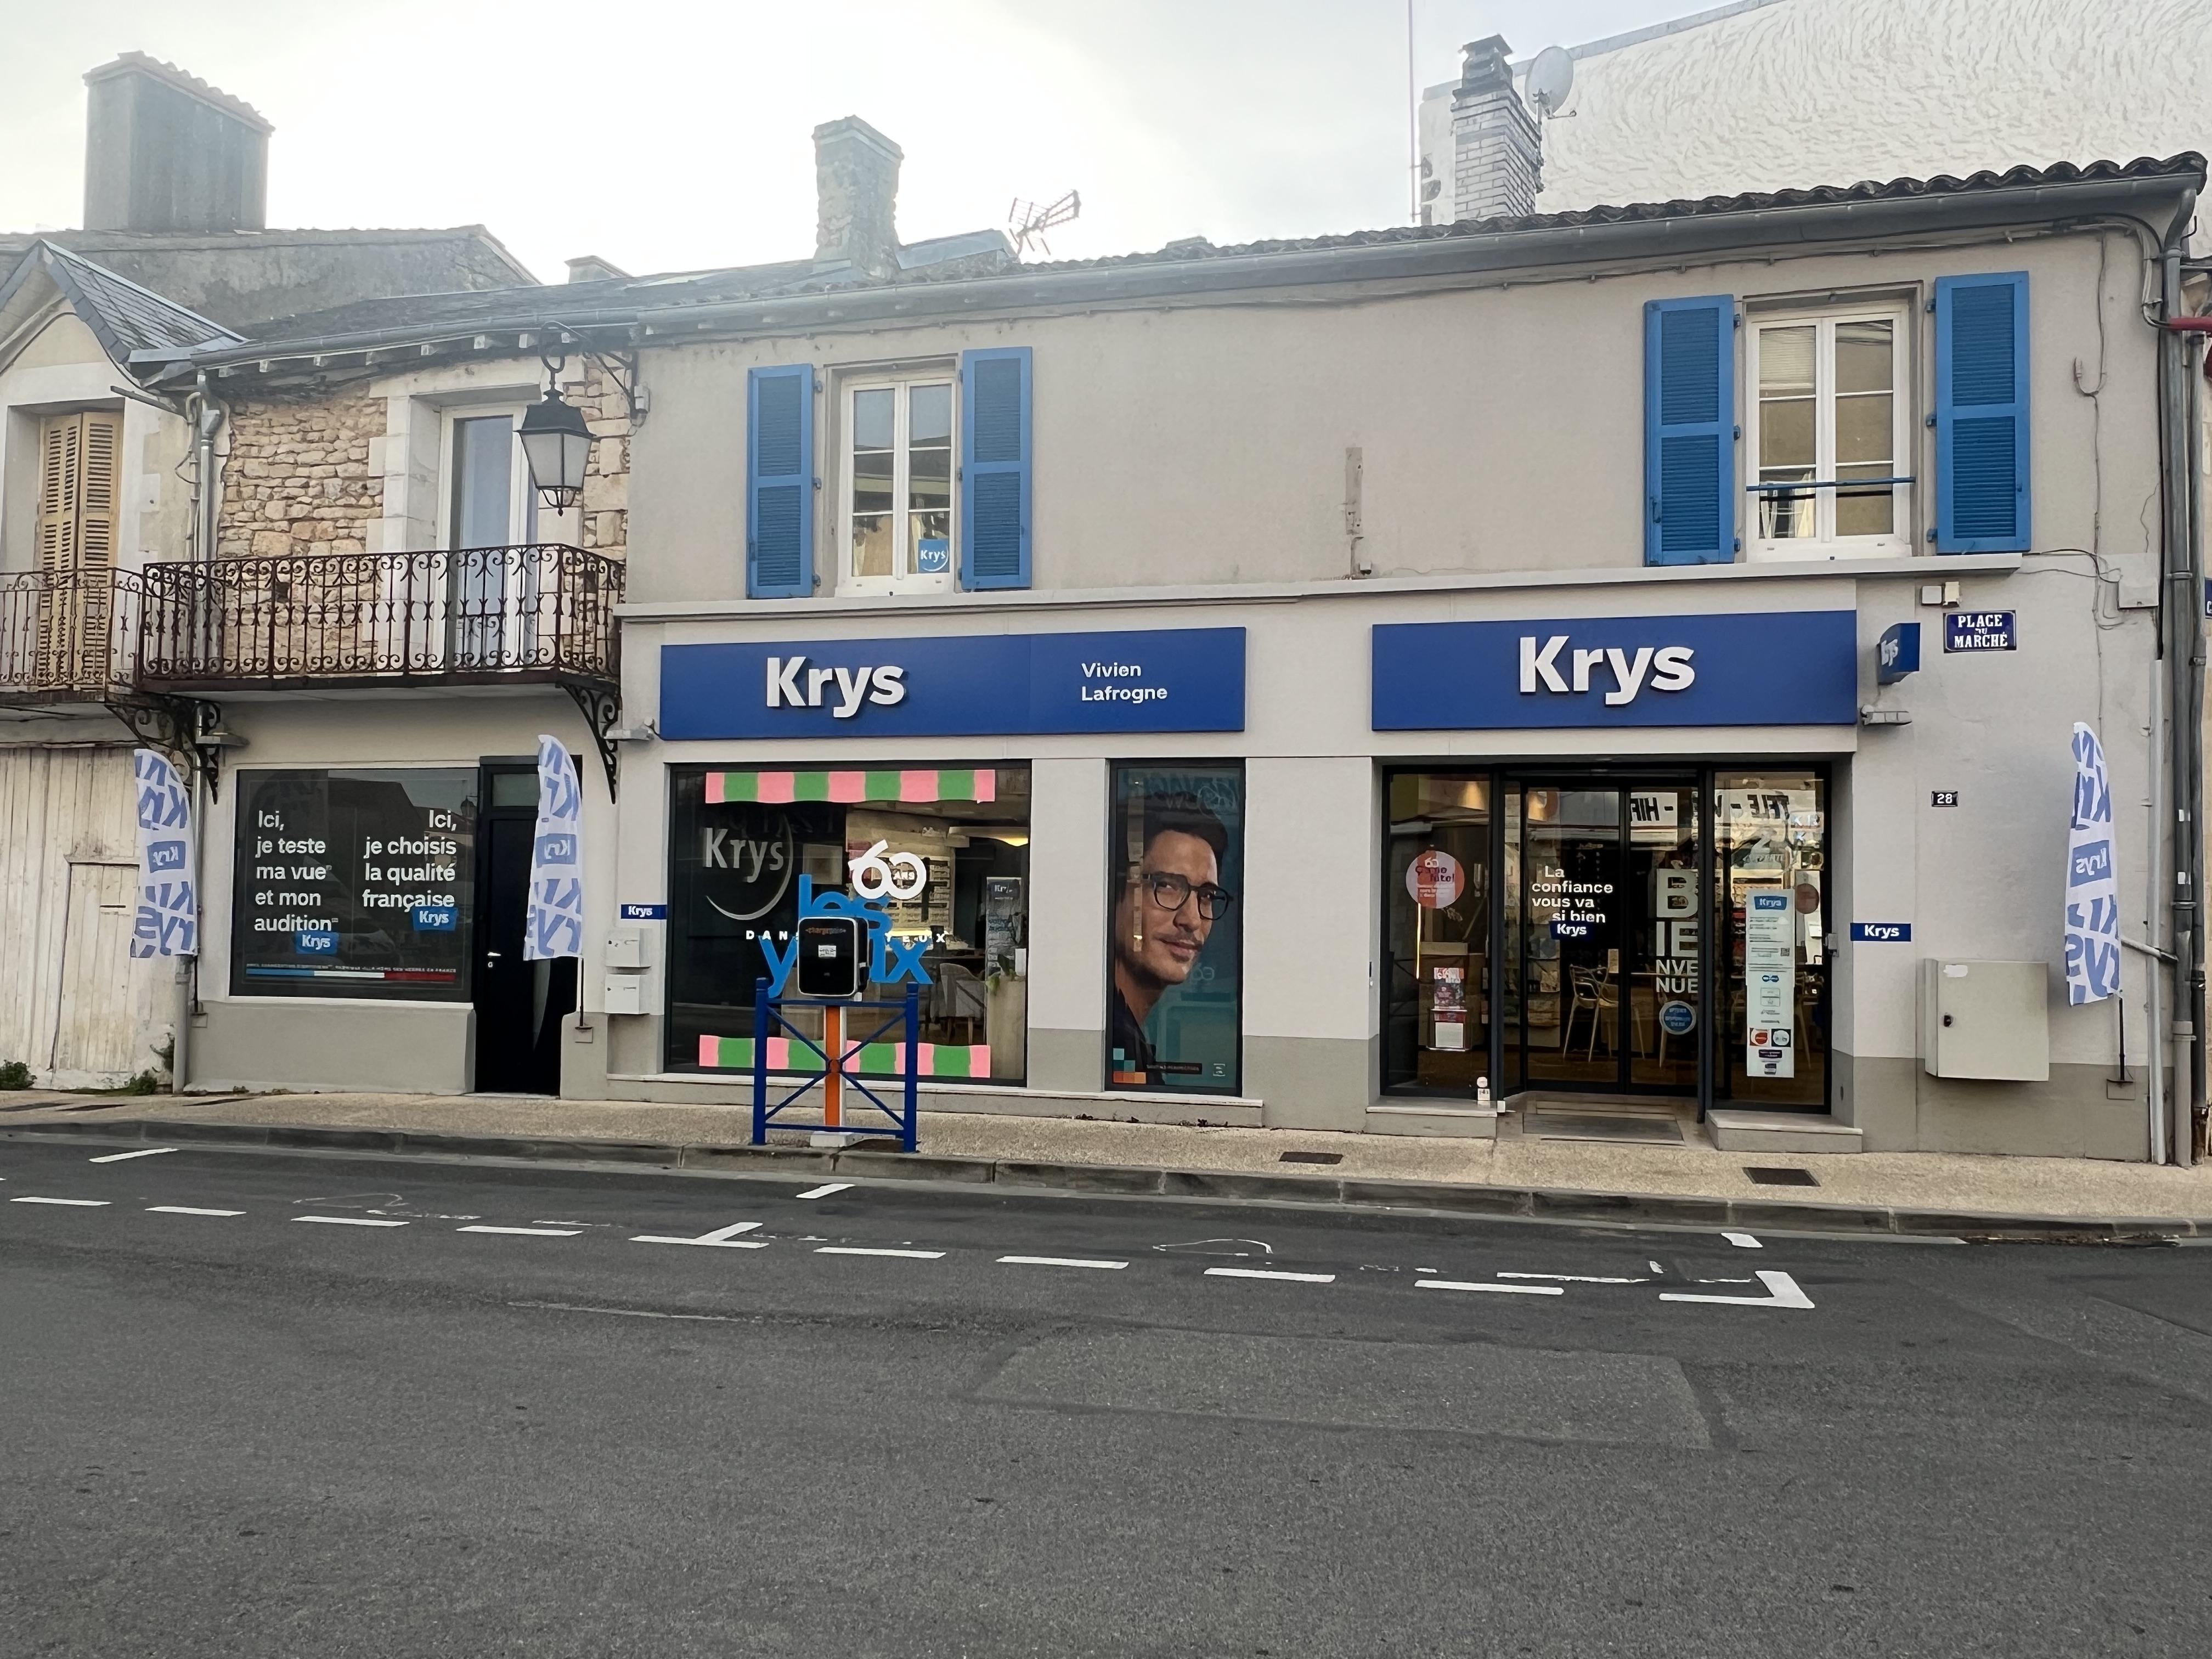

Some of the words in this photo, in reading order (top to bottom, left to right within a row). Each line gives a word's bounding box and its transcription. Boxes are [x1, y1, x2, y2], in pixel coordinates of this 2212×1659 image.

[920, 550, 946, 563] Krys
[1957, 614, 2002, 628] PLACE
[1954, 632, 2008, 648] MARCHÉ
[1081, 662, 1142, 678] Vivien
[1519, 635, 1695, 706] Krys
[766, 656, 905, 718] Krys
[1081, 686, 1167, 704] Lafrogne
[1937, 793, 1953, 804] 28
[258, 810, 284, 831] Ici,
[429, 810, 456, 831] Ici,
[255, 836, 273, 858] je
[278, 838, 326, 854] teste
[363, 837, 382, 859] je
[387, 837, 456, 855] choisis
[703, 827, 784, 883] Krys
[256, 866, 285, 879] ma
[291, 866, 327, 880] vue
[365, 863, 382, 881] la
[387, 863, 455, 886] qualité
[1545, 866, 1565, 877] La
[1532, 881, 1613, 893] confiance
[255, 890, 274, 905] et
[279, 893, 321, 906] mon
[362, 889, 455, 912] française
[1532, 898, 1570, 907] vous
[1575, 899, 1594, 907] va
[419, 911, 449, 927] Krys
[628, 906, 653, 917] Krys
[1552, 910, 1565, 921] si
[1571, 910, 1606, 923] bien
[254, 915, 332, 932] audition
[1557, 924, 1587, 937] Krys
[1865, 924, 1899, 939] Krys
[302, 934, 330, 950] Krys
[758, 935, 934, 998] yx
